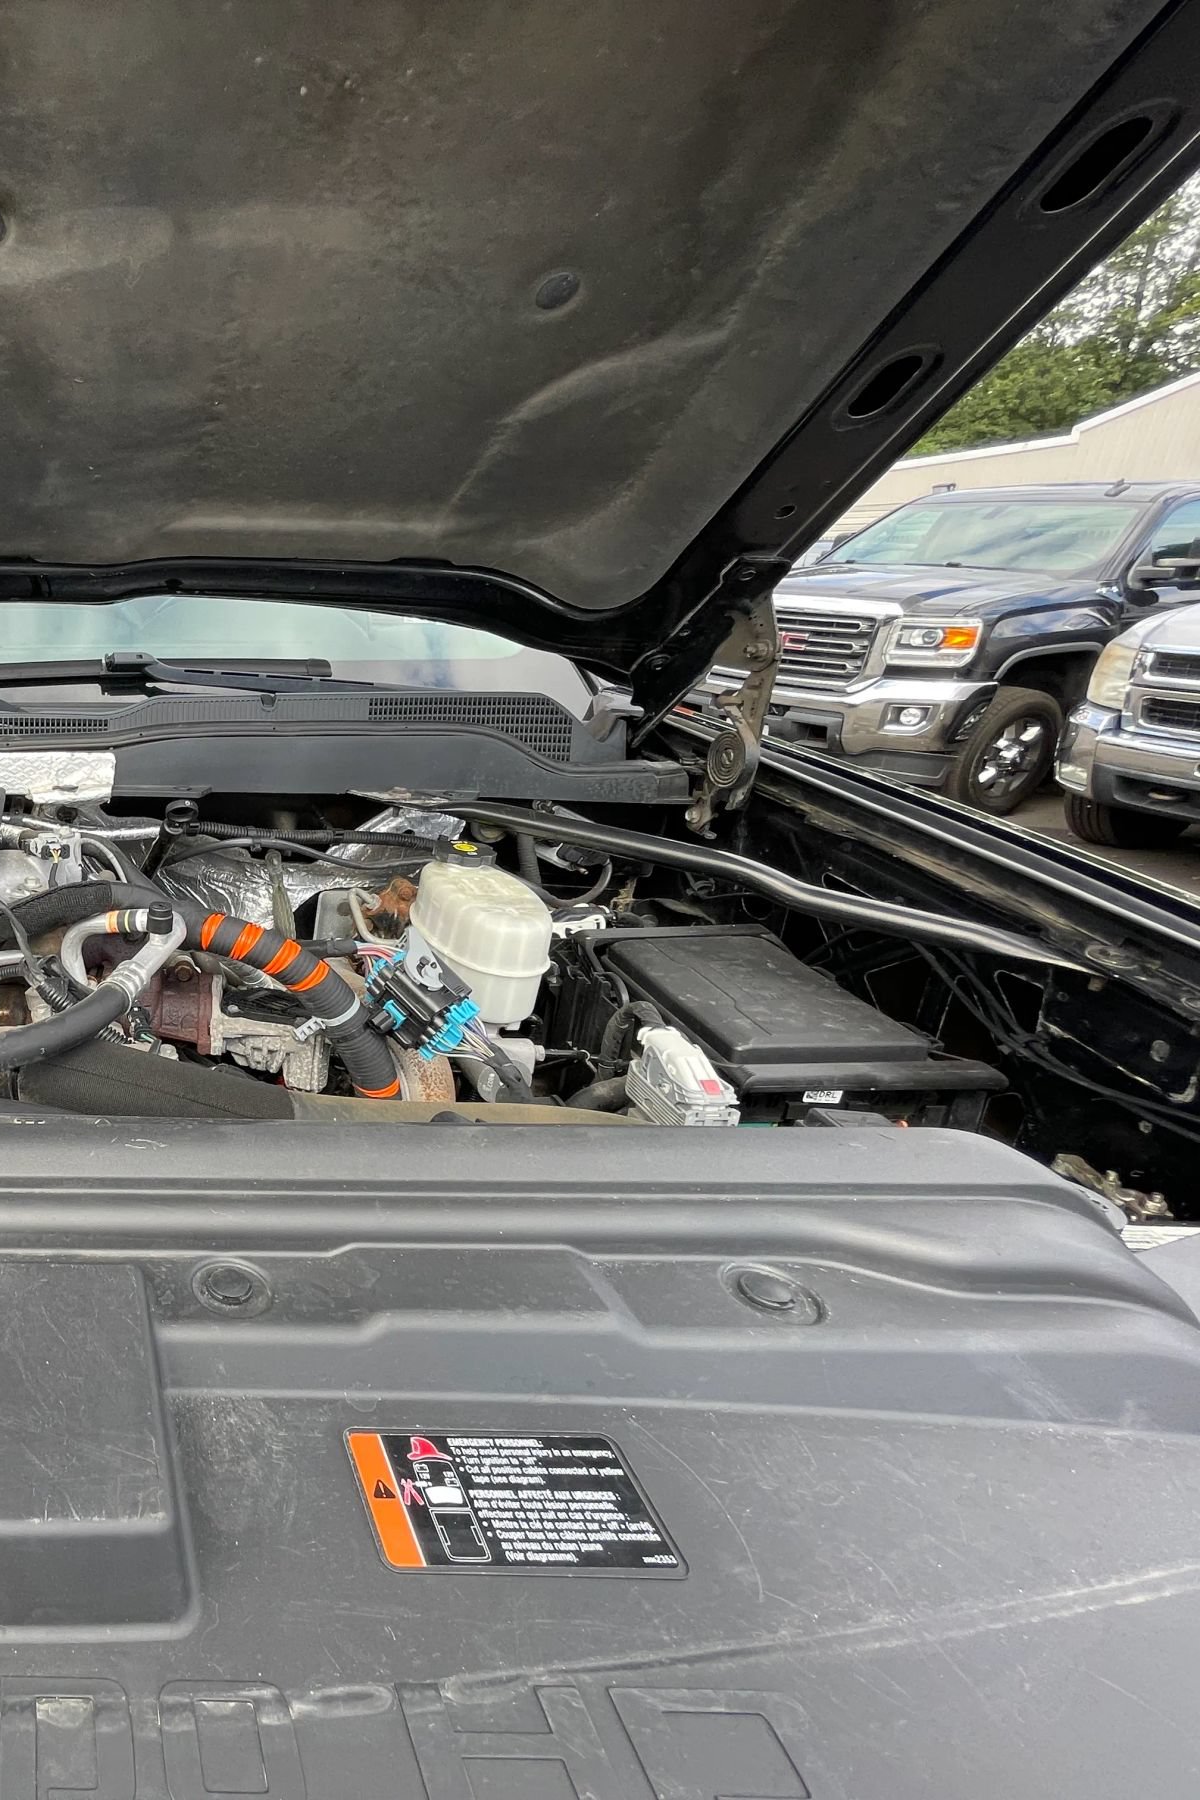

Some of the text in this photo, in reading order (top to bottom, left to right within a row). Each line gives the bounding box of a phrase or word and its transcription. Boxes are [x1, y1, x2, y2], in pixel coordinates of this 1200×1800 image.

[818, 1090, 838, 1099] DRL
[446, 1437, 544, 1448] EMERGENCY PERSONNEL:
[450, 1447, 462, 1455] To
[461, 1447, 479, 1457] help
[478, 1447, 500, 1456] avoid
[499, 1447, 532, 1457] personal
[530, 1447, 553, 1458] injury
[561, 1449, 573, 1457] an
[461, 1456, 481, 1465] Turn
[480, 1456, 511, 1466] ignition
[508, 1456, 520, 1465] to
[465, 1464, 480, 1474] Cut
[491, 1465, 523, 1475] positive
[522, 1465, 549, 1475] cables
[548, 1466, 590, 1476] connected
[597, 1467, 625, 1478] yellow
[471, 1474, 547, 1486] tape (see diagram).
[468, 1488, 617, 1501] PERSONNEL AFFECTÉ AUX URGENCES
[474, 1499, 491, 1509] Afin
[520, 1500, 544, 1510] toute
[542, 1500, 569, 1510] lésion
[477, 1509, 515, 1519] effectuer
[513, 1510, 527, 1519] ce
[525, 1510, 541, 1521] qui
[540, 1510, 558, 1520] suit
[556, 1511, 570, 1520] en
[568, 1511, 585, 1520] cas
[491, 1519, 520, 1529] Mettre
[518, 1519, 530, 1529] la
[528, 1518, 544, 1530] clé
[542, 1519, 556, 1530] de
[554, 1520, 587, 1531] contact
[585, 1522, 600, 1531] sur
[495, 1529, 526, 1541] Couper
[524, 1530, 547, 1540] tous
[544, 1530, 561, 1540] les
[586, 1530, 620, 1542] positifs
[617, 1530, 662, 1542] connectés
[500, 1540, 604, 1553] au niveau du ruban jaune
[392, 1681, 850, 1800] HD
